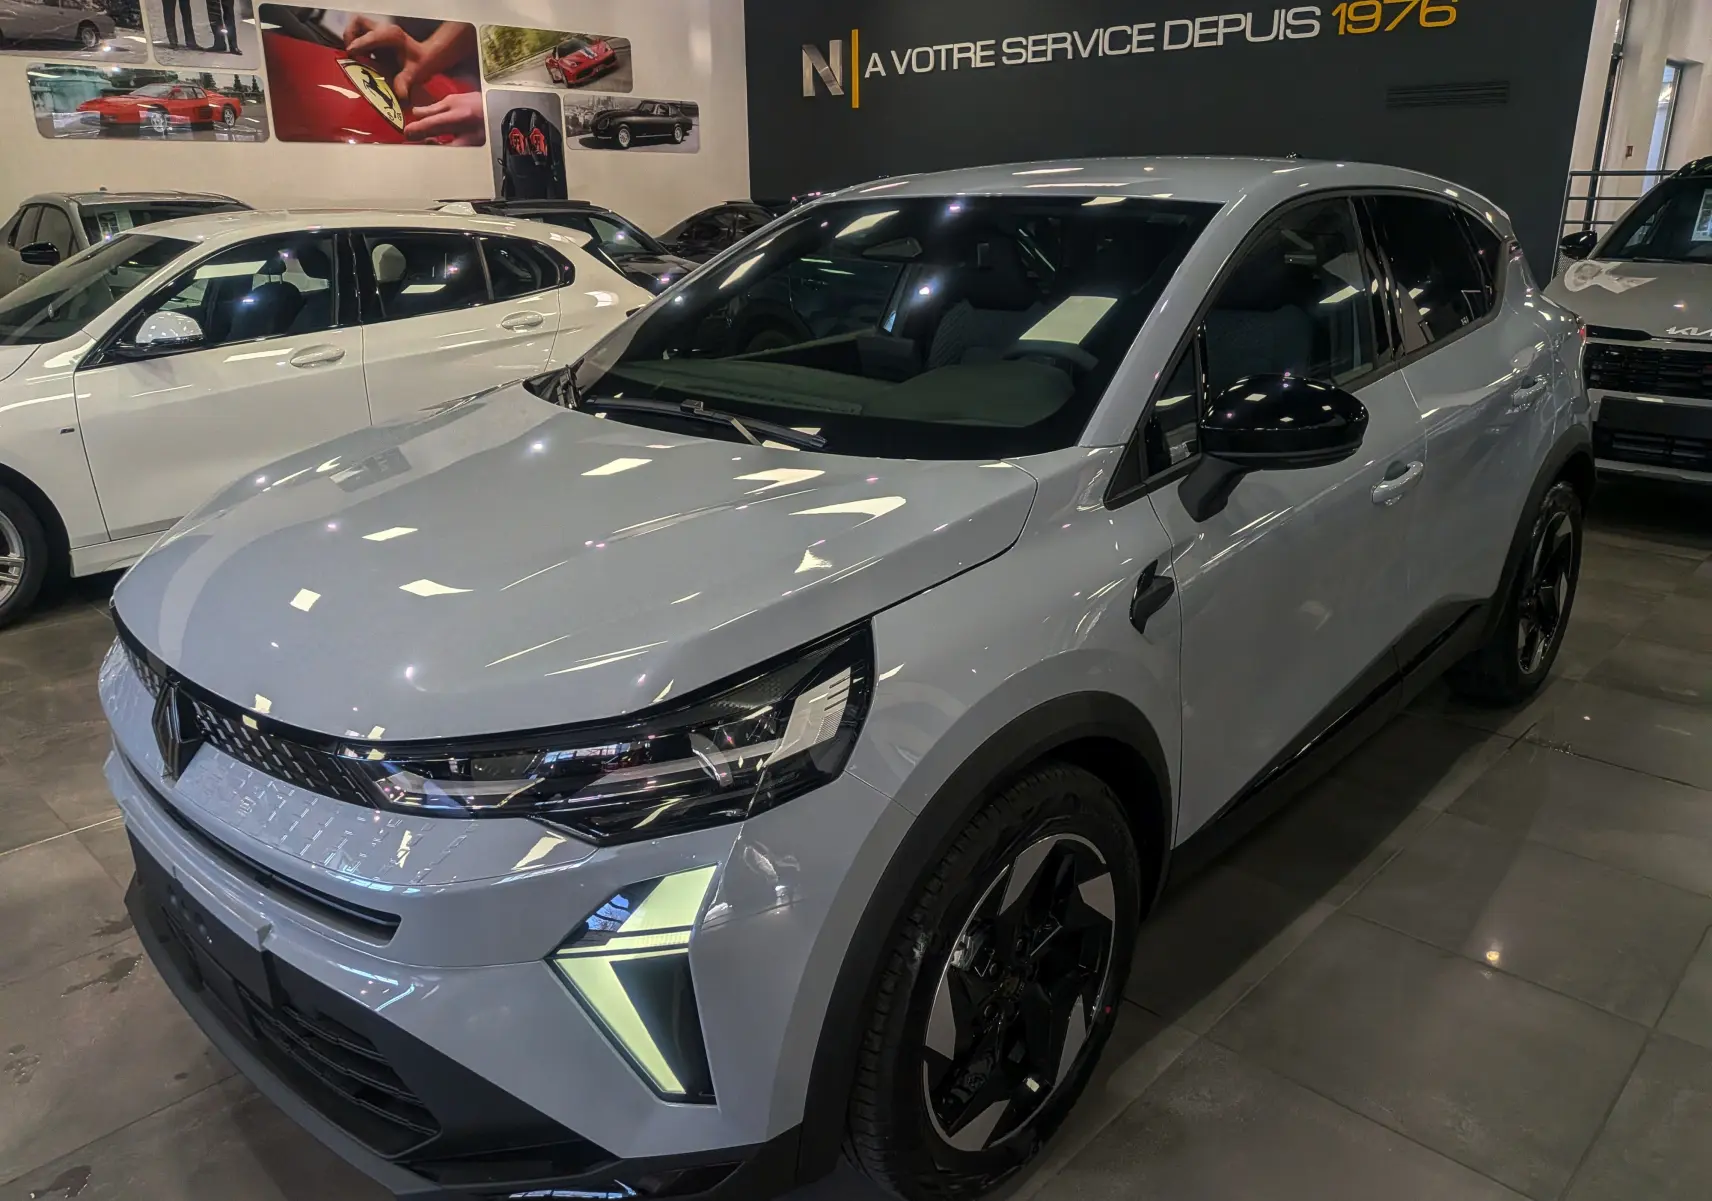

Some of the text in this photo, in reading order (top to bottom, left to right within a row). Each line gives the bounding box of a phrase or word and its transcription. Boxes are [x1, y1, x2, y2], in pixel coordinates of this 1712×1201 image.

[802, 39, 844, 97] N
[864, 0, 1458, 78] A VOTRE SERVICE DEPUIS 1976
